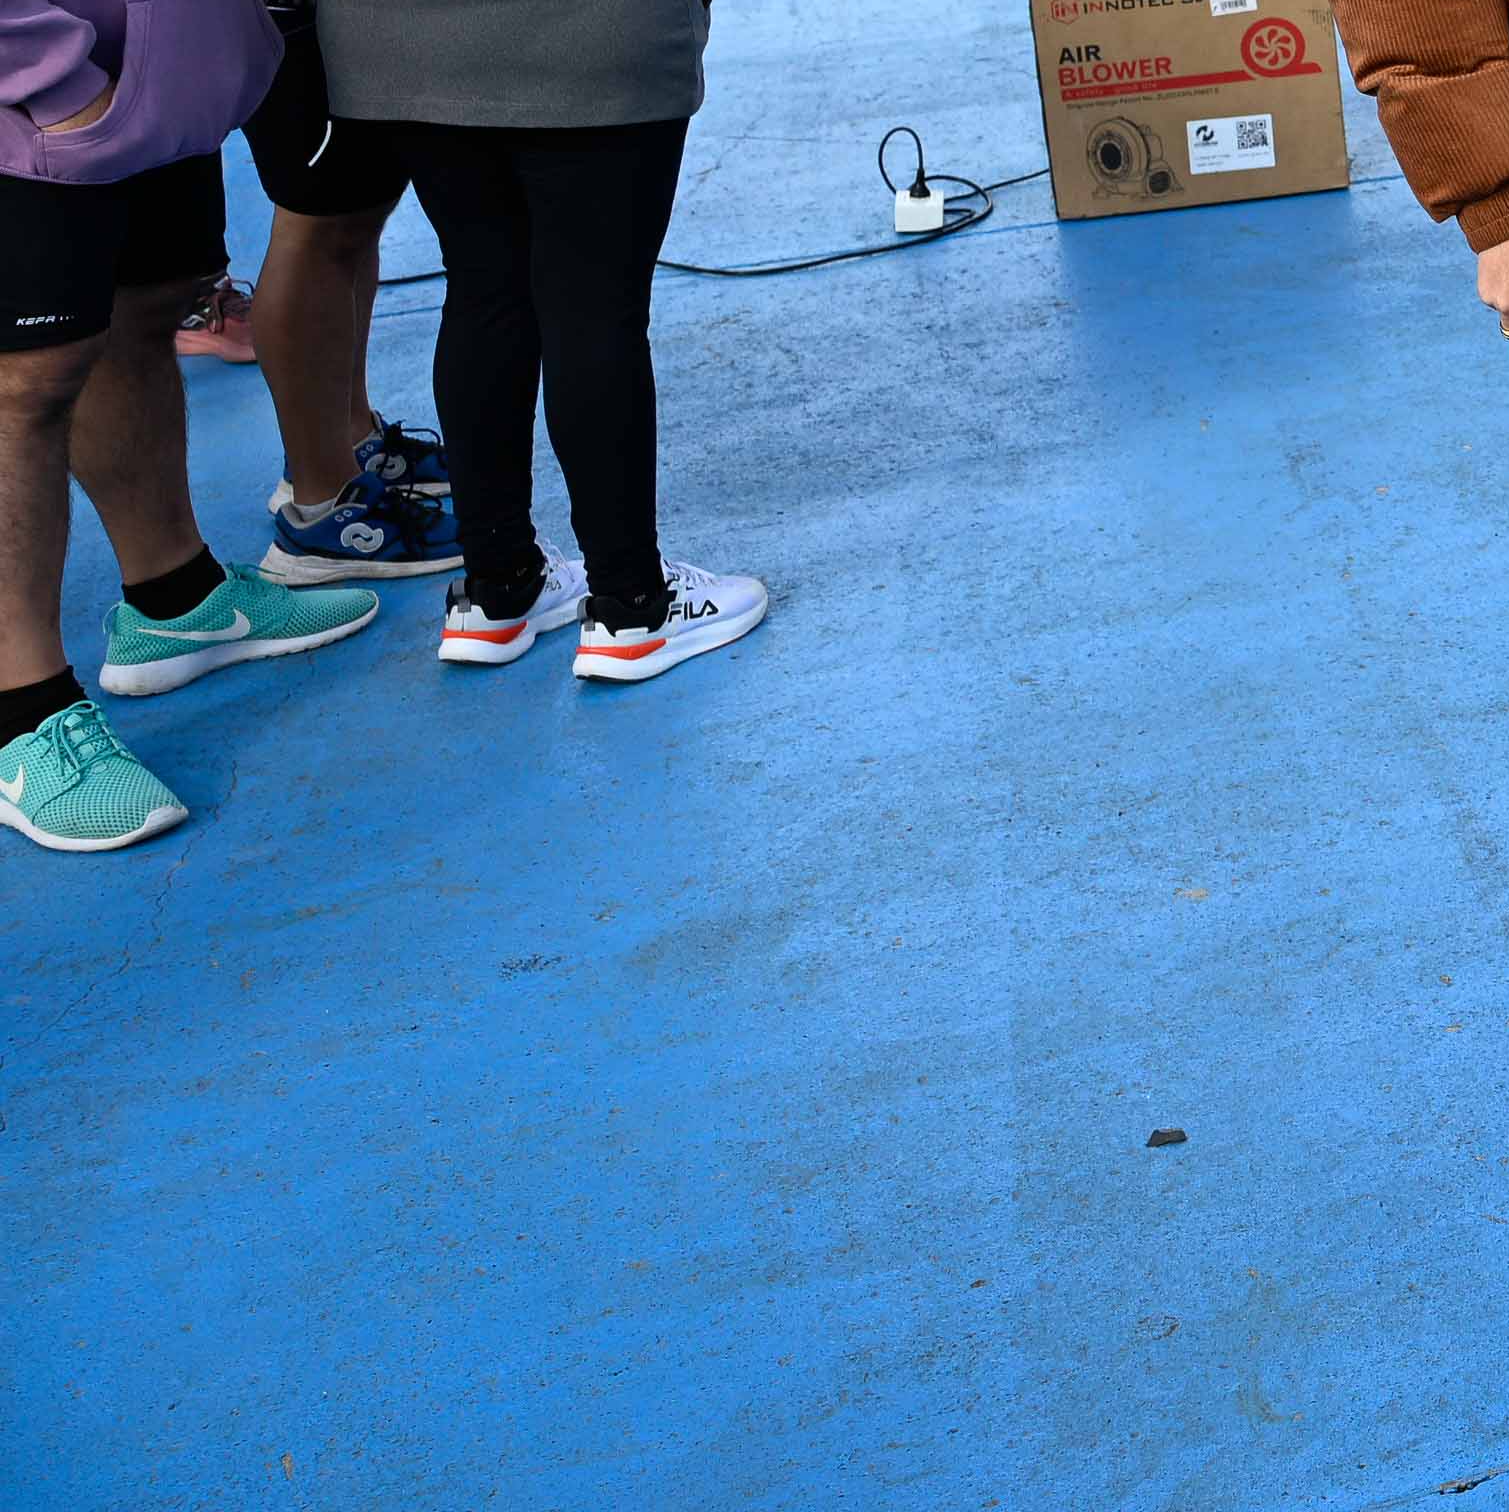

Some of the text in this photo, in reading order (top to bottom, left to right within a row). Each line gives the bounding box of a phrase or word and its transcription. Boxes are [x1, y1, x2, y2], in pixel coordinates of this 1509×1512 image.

[1059, 45, 1102, 65] AIR
[1058, 57, 1172, 87] BLOWER
[668, 599, 719, 624] FILA
